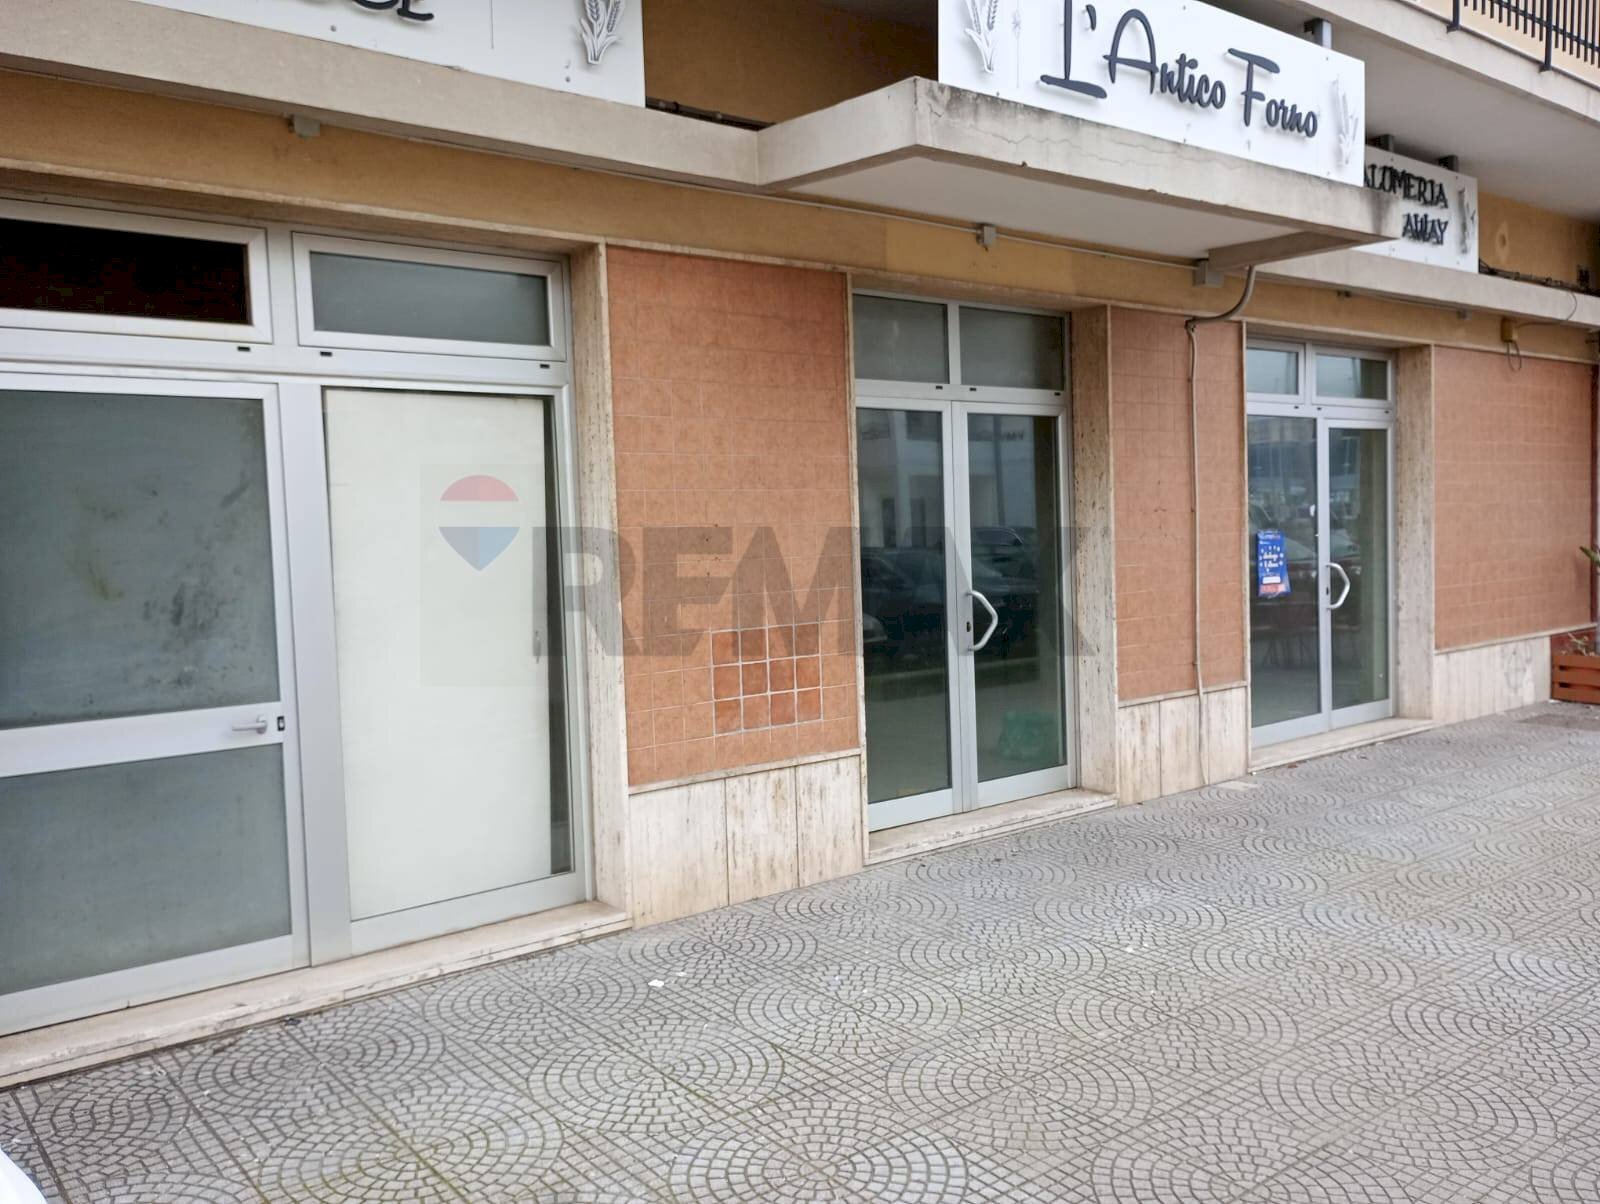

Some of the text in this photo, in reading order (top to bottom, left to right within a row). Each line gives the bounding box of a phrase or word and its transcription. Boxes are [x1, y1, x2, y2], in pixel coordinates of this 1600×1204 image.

[1040, 0, 1319, 137] L'Antico Forno
[1402, 213, 1448, 245] AWAY
